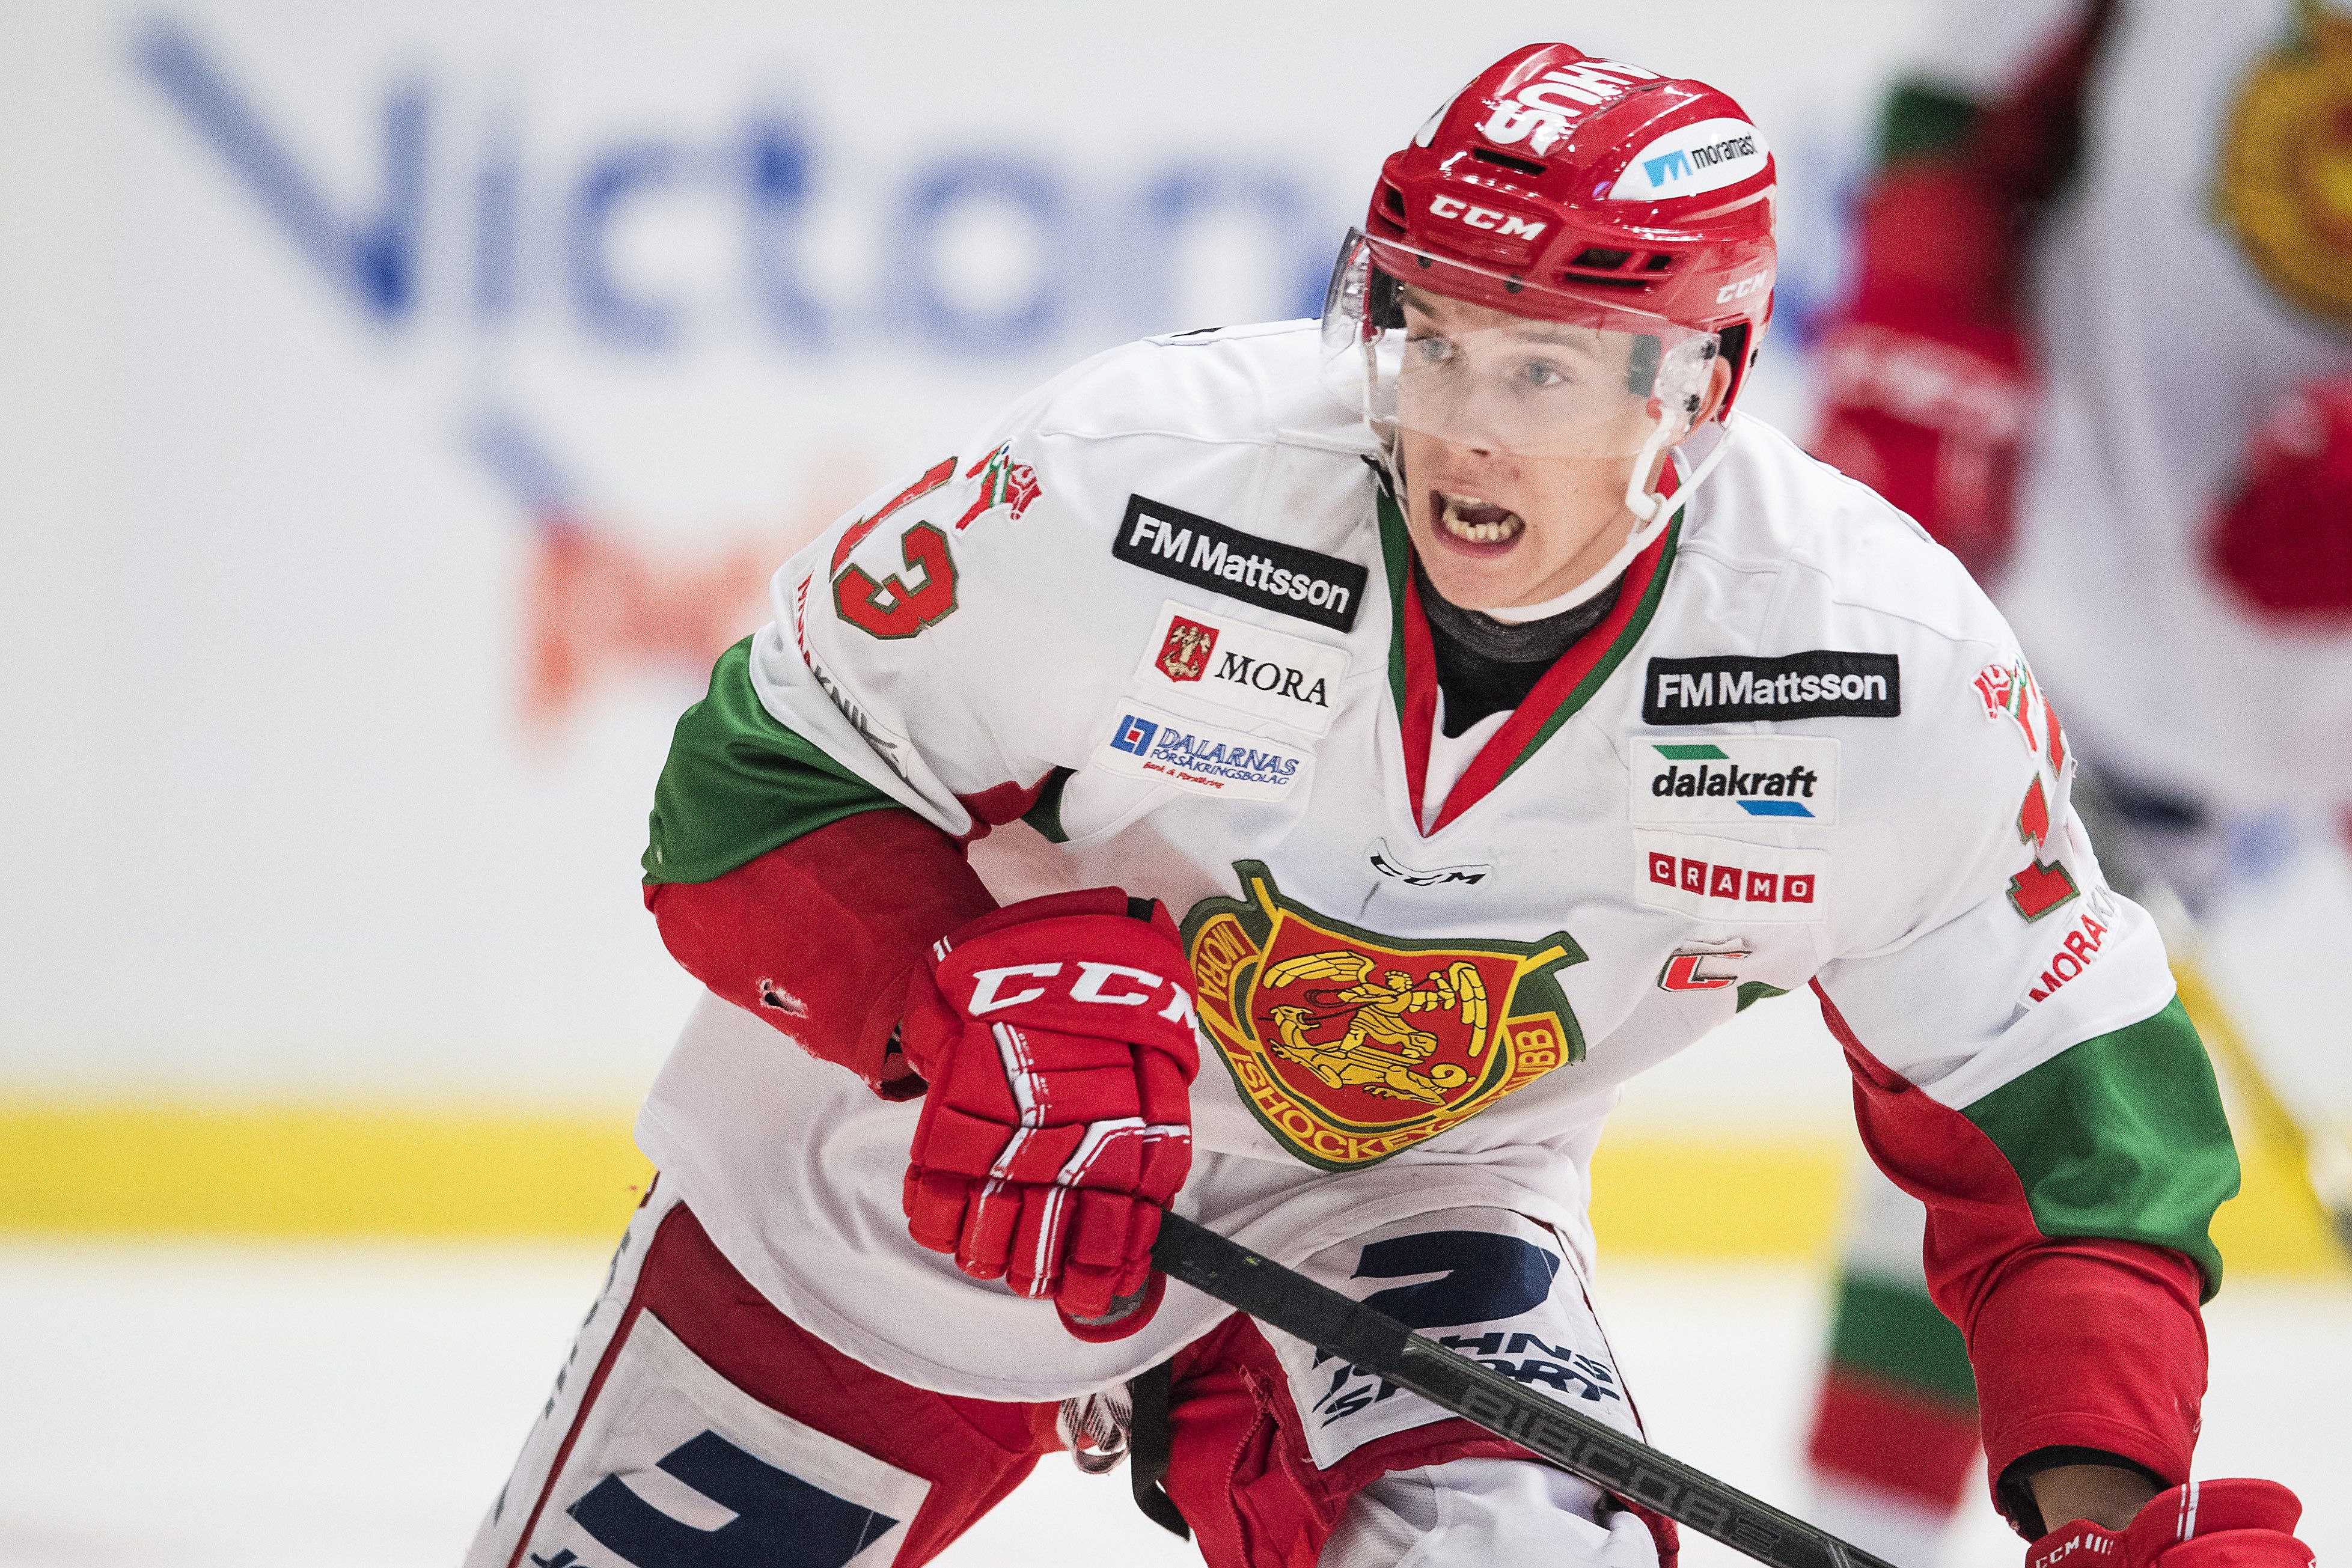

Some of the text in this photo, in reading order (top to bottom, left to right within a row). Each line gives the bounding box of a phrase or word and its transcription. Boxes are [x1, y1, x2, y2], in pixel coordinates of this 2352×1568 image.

[1429, 194, 1547, 240] CCM
[1716, 270, 1768, 304] CCM
[1129, 513, 1351, 614] FM Mattsson
[1215, 651, 1329, 708] MORA
[1657, 670, 1887, 709] FM Mattsson
[1157, 727, 1299, 776] DALARNAS
[1652, 764, 1818, 798] dalakraft
[1370, 855, 1485, 886] CCM
[1653, 858, 1809, 898] CRAMO
[1197, 921, 1245, 1002] MORA
[1657, 950, 1752, 992] C
[2035, 1534, 2080, 1568] CCM
